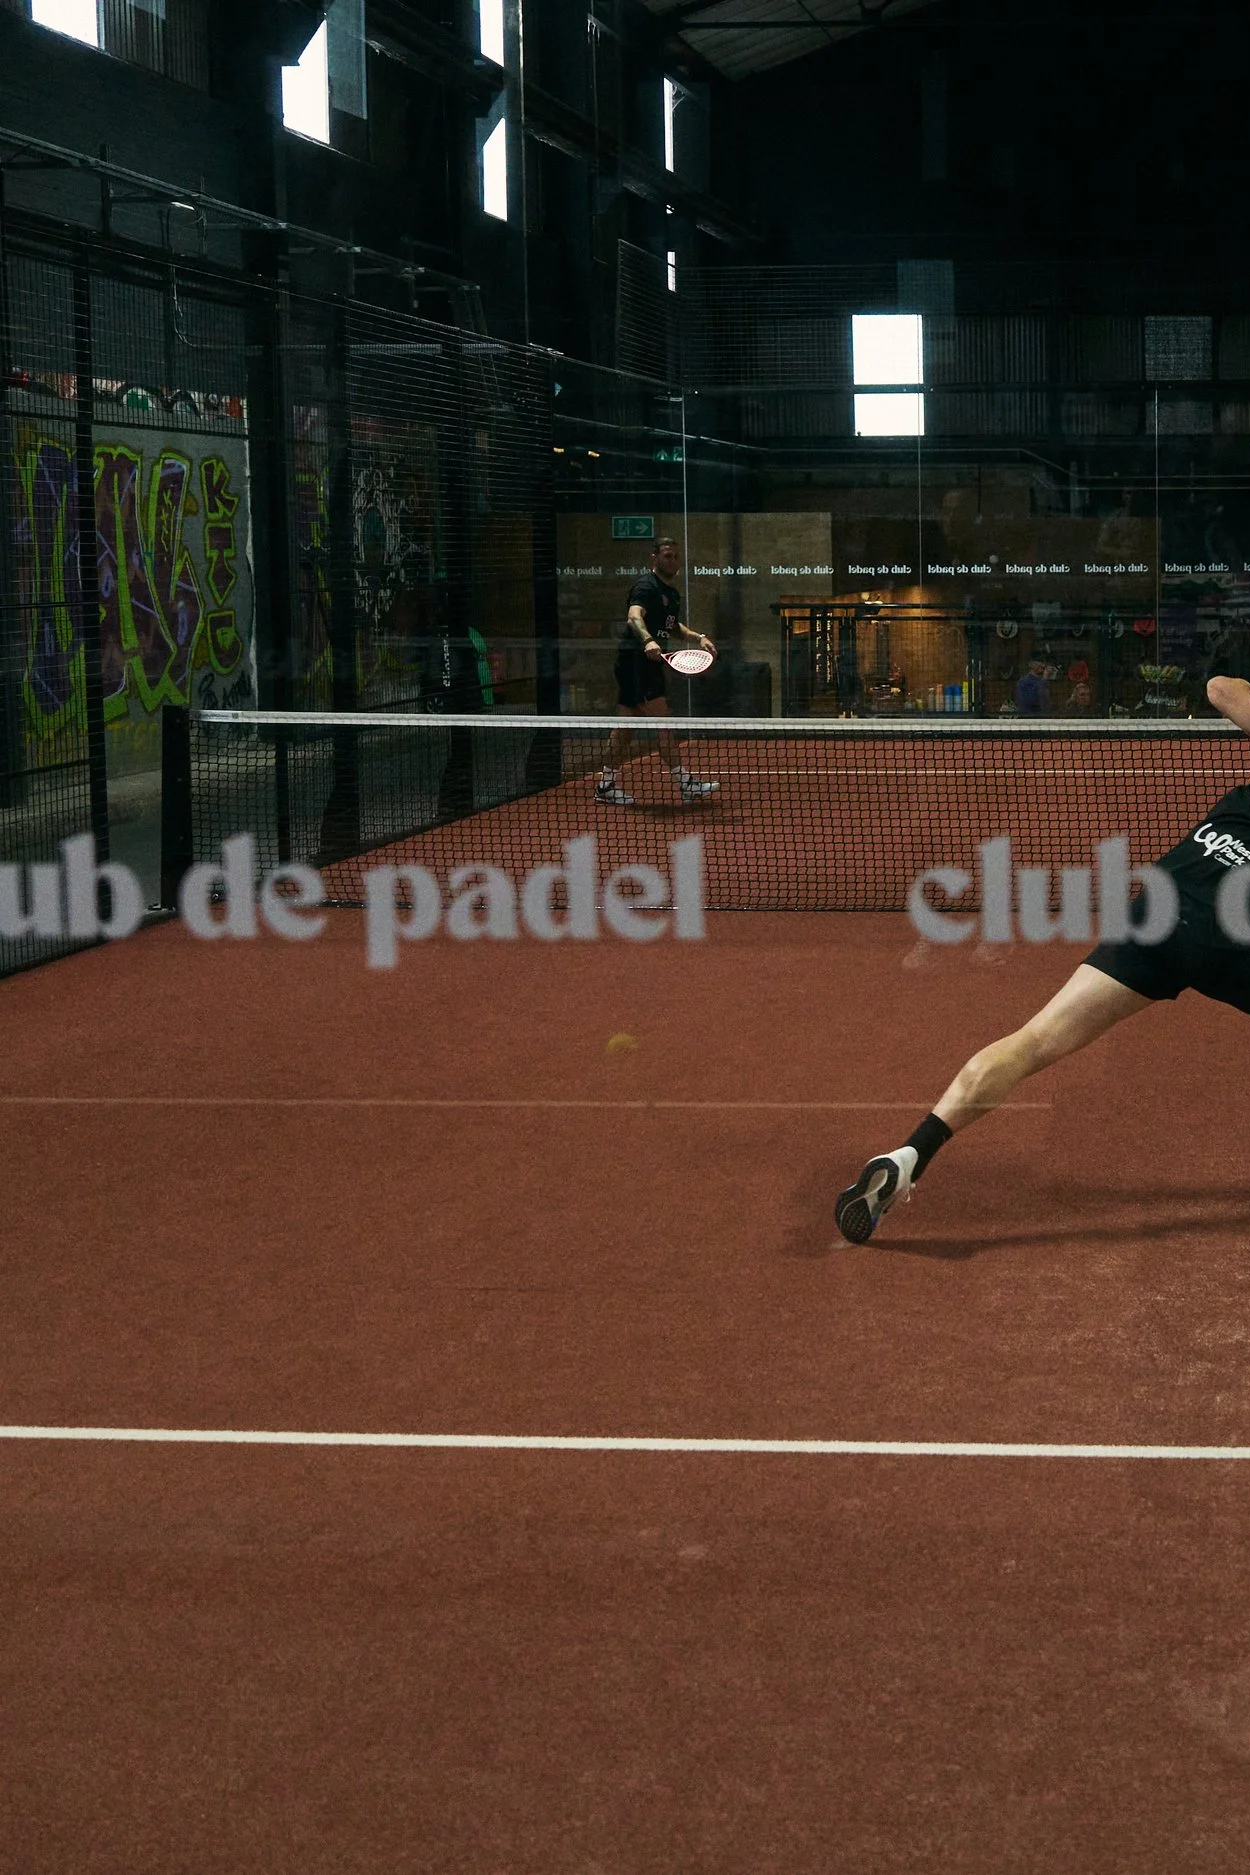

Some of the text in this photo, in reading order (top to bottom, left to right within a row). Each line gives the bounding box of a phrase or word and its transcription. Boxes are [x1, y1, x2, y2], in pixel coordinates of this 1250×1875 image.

[577, 566, 602, 577] padel
[1219, 846, 1246, 866] Park
[178, 831, 327, 941] de
[363, 832, 708, 970] padel
[906, 834, 1182, 945] club
